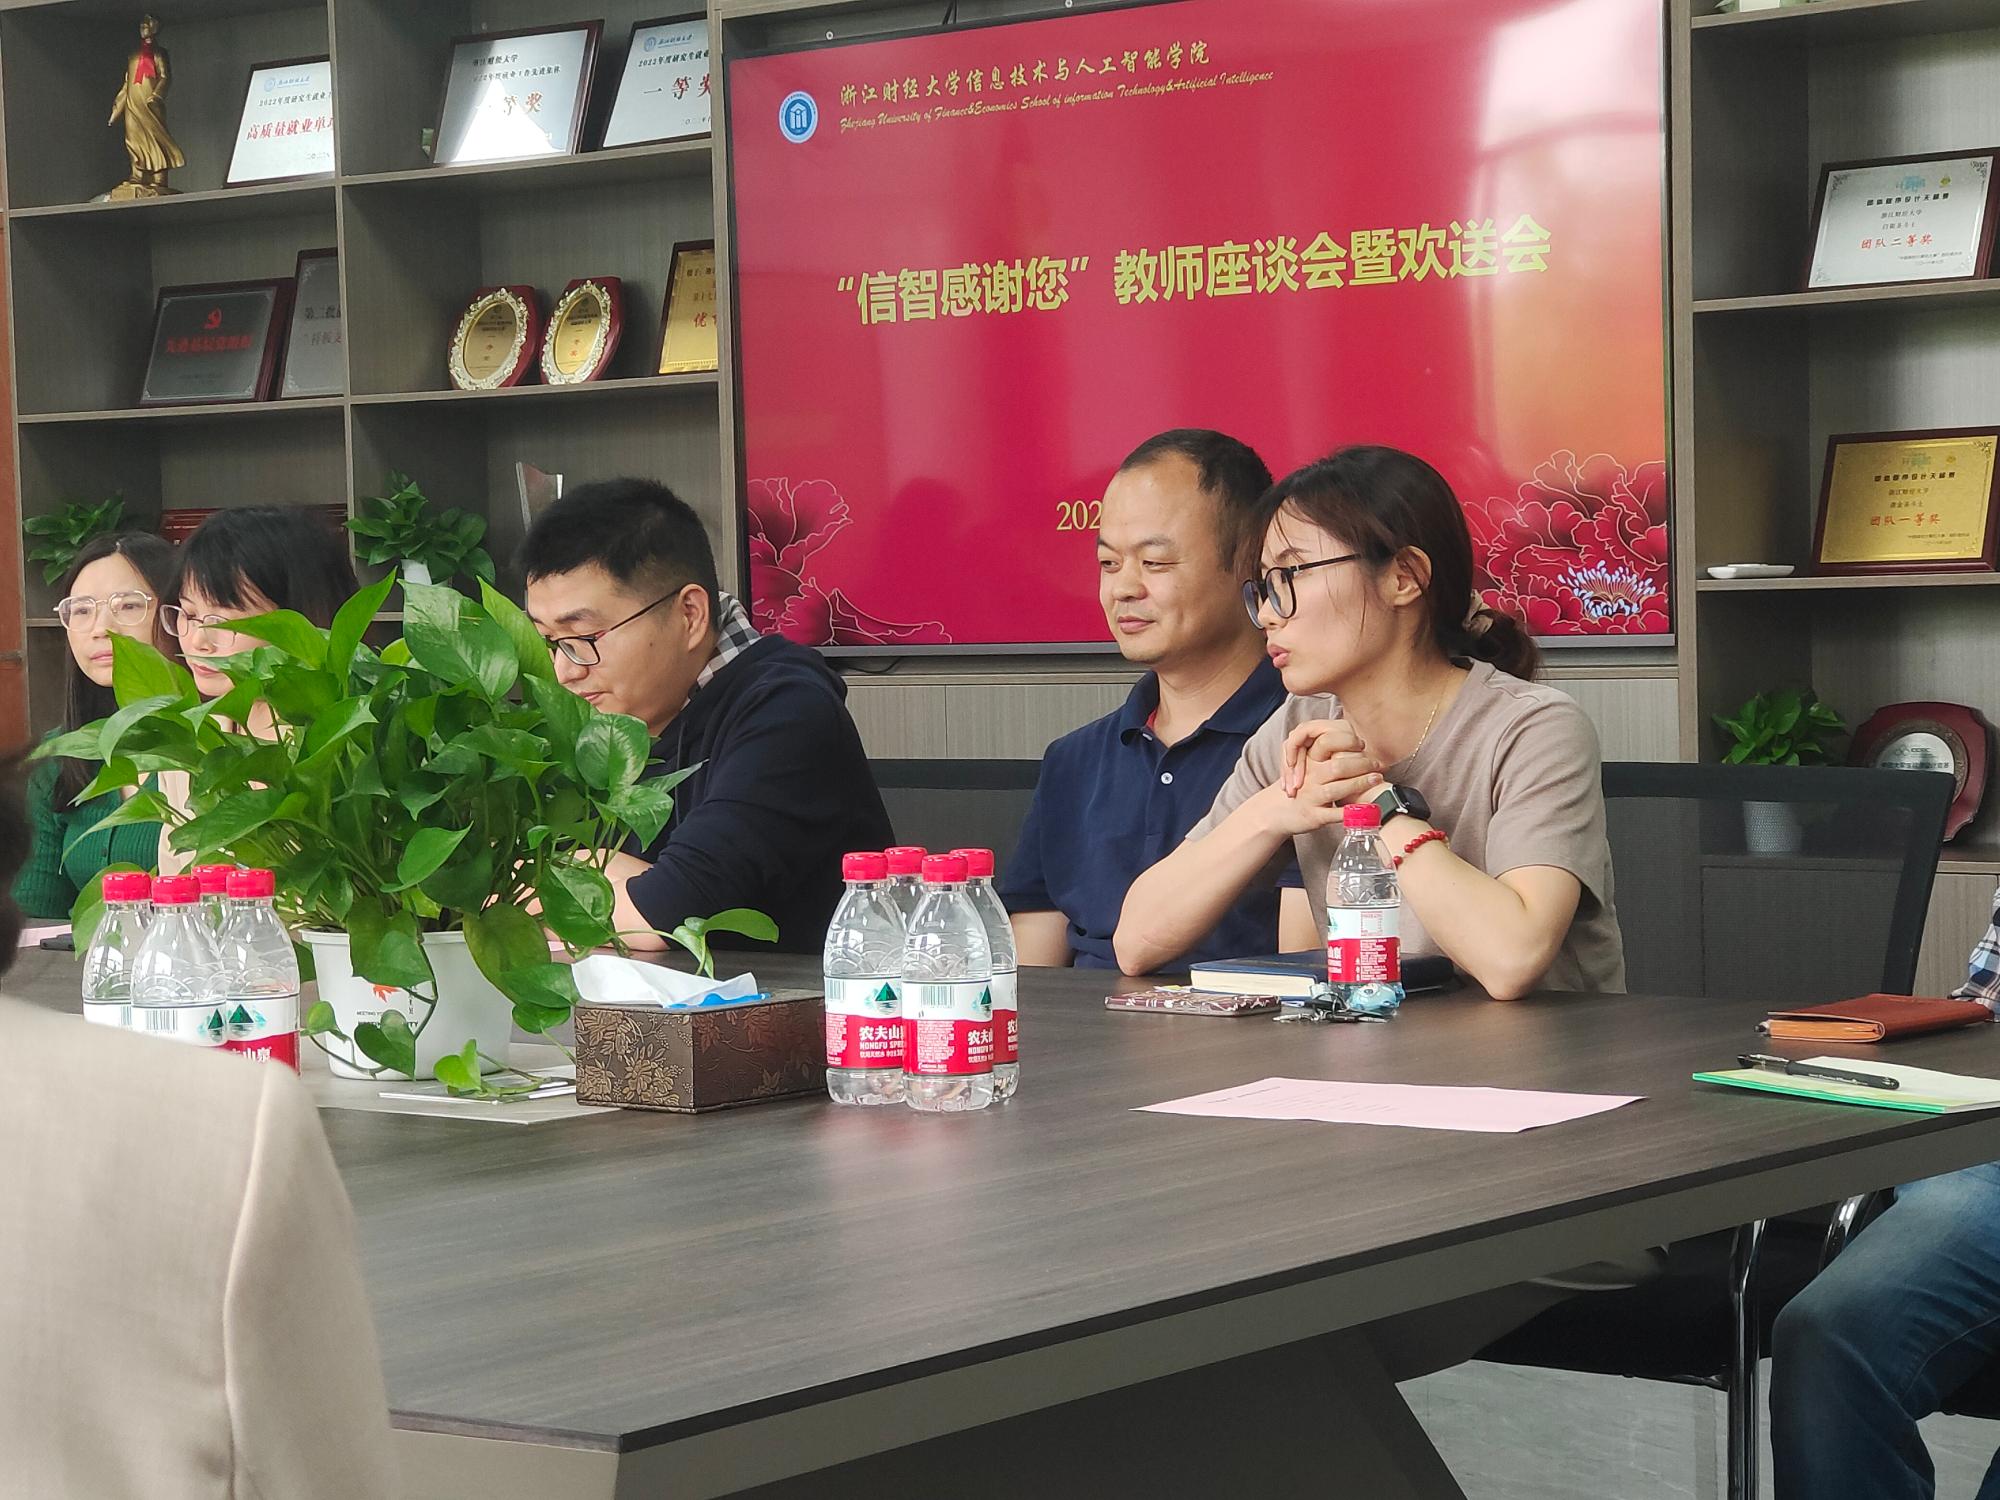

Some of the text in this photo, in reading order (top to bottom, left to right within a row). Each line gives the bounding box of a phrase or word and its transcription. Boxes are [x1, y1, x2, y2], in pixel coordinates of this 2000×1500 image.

[840, 42, 1211, 107] 浙江财经大学信息技术与人工智能学院
[489, 91, 543, 116] 等奖
[840, 117, 876, 134] Zhejiang
[878, 112, 921, 126] University
[924, 109, 933, 122] of
[1020, 93, 1051, 110] School
[1052, 91, 1062, 108] of
[1064, 87, 1114, 106] information
[1219, 70, 1274, 87] Intelligence
[1860, 233, 1933, 249] 团队二等奖
[1056, 499, 1102, 531] 202
[1870, 512, 1941, 527] 团队一等奖
[859, 1025, 904, 1042] 农夫山
[860, 1041, 888, 1050] NONGFU
